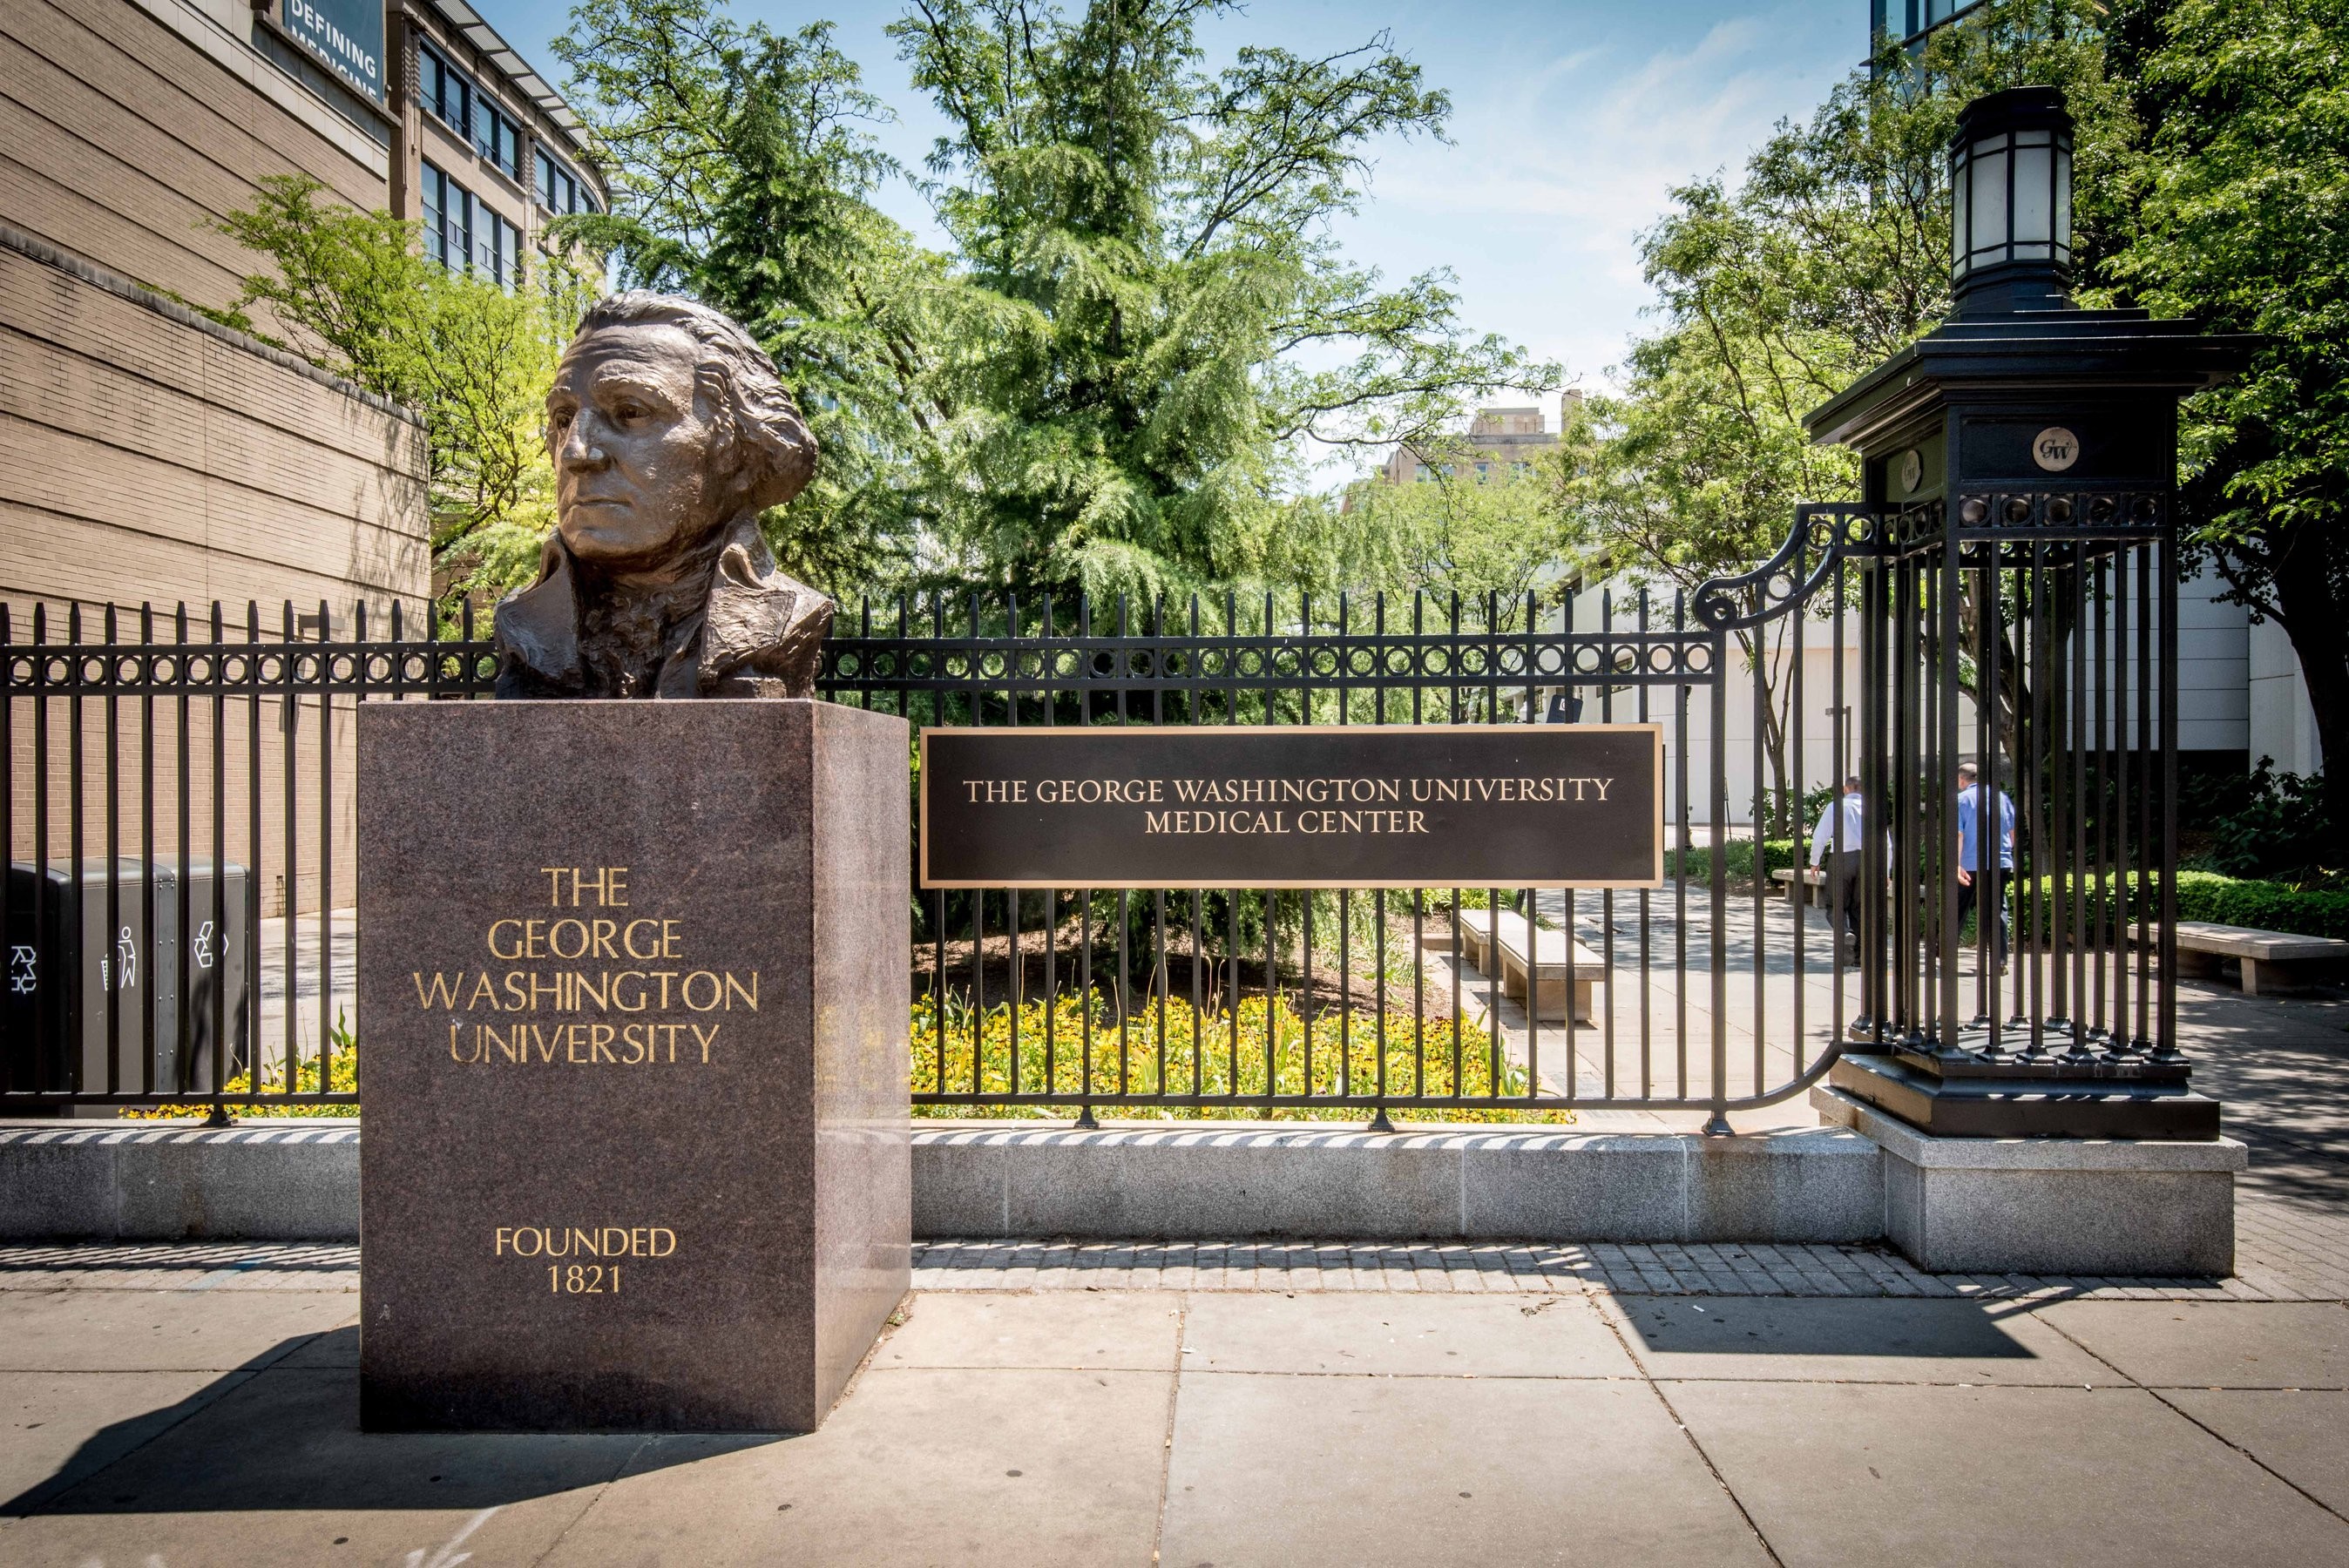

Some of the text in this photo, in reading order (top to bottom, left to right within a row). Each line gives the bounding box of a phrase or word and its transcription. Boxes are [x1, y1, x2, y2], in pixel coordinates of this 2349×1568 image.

[292, 0, 376, 78] DEFINING
[963, 777, 1615, 803] THE GEORGE WASHINGTON UNIVERSITY
[1144, 809, 1430, 834] MEDICAL CENTER
[540, 867, 629, 907] THE
[487, 918, 682, 960] GEORGE
[412, 970, 759, 1012] WASHINGTON
[450, 1024, 721, 1064] UNIVERSITY
[496, 1227, 676, 1257] FOUNDED
[547, 1265, 619, 1294] 1821
